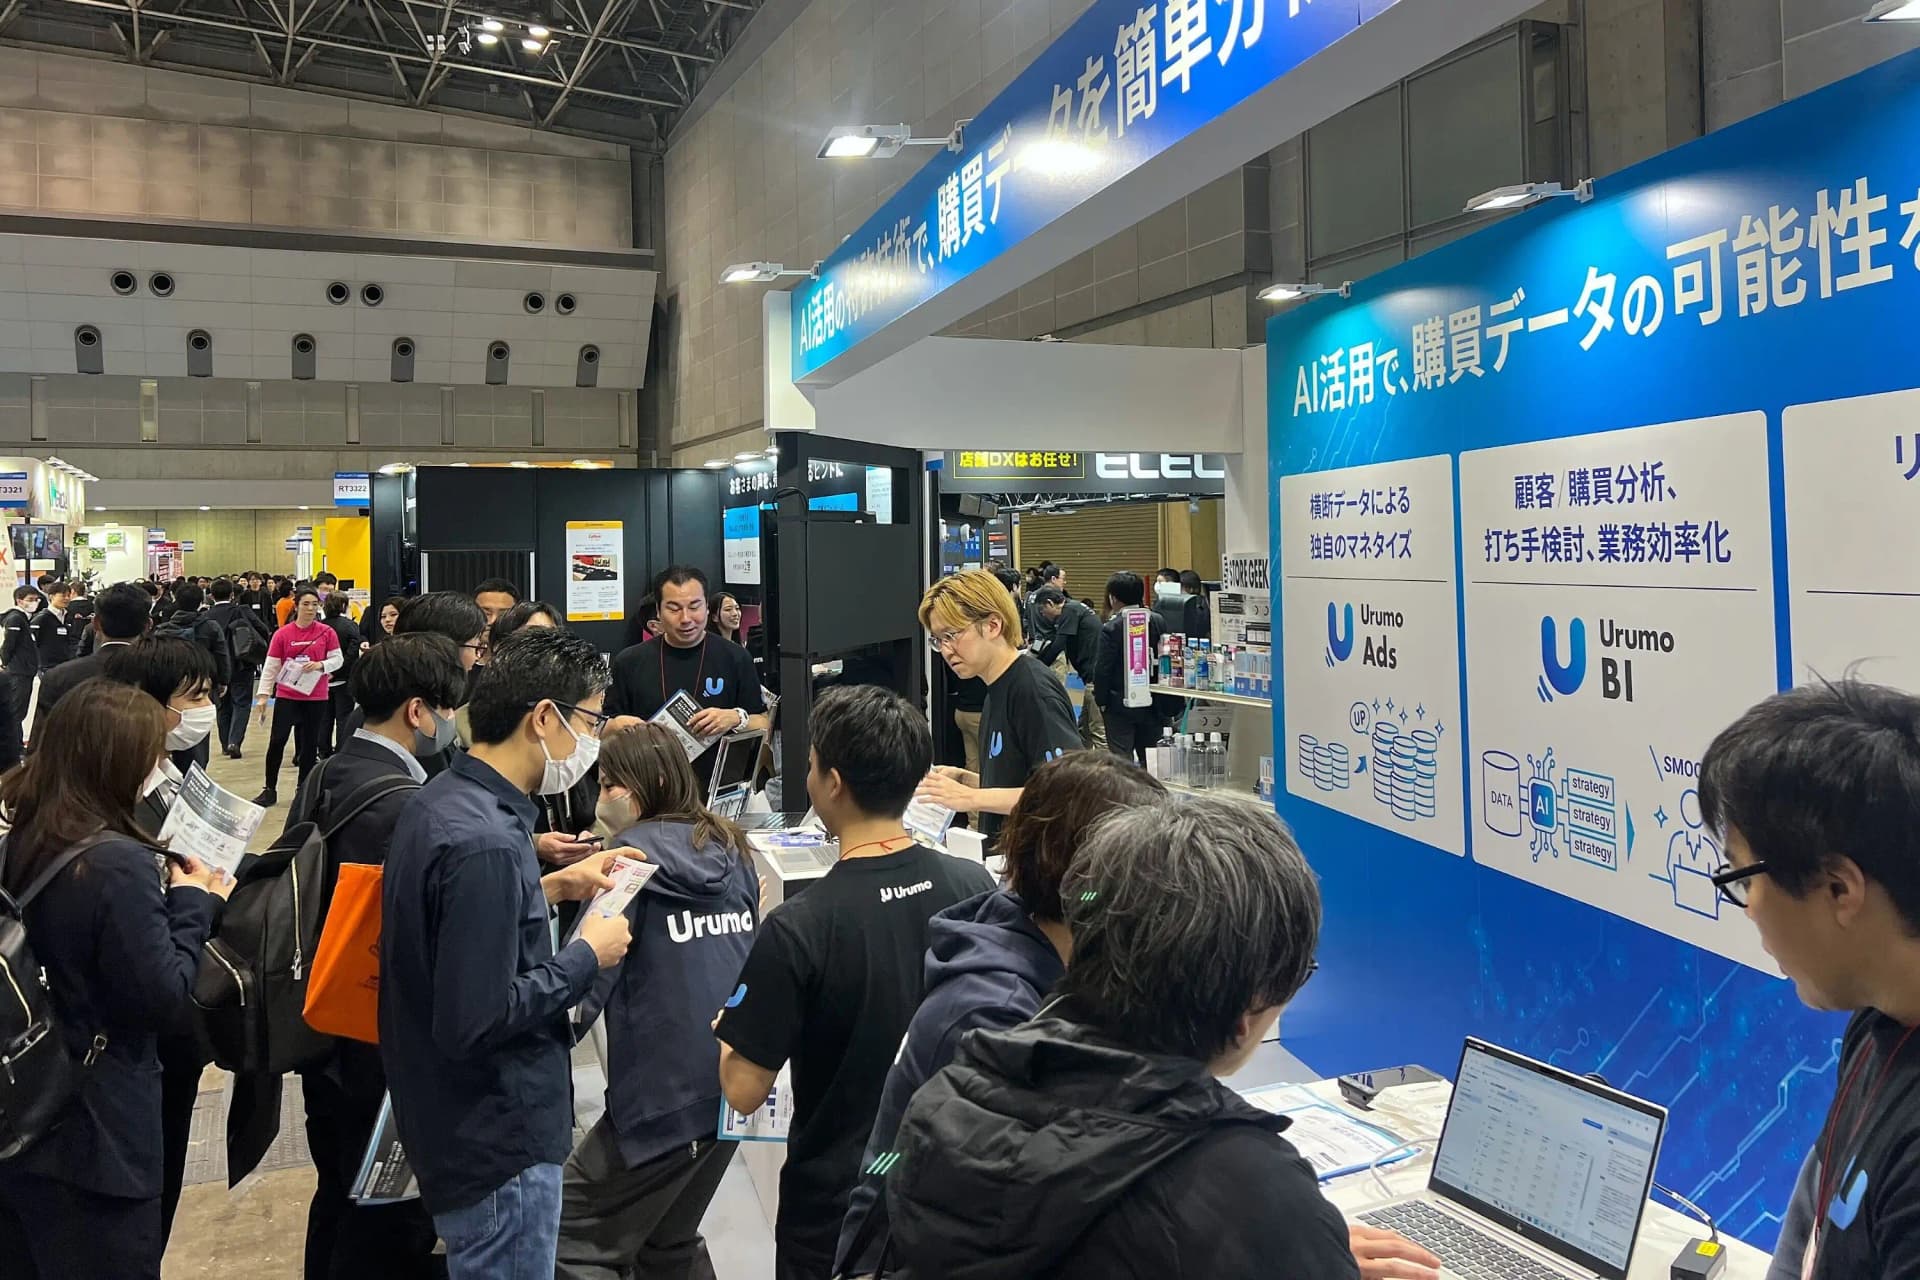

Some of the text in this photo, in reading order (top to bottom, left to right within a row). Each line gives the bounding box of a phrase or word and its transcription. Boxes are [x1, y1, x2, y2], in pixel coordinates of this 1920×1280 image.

[338, 485, 367, 493] RT3322
[1310, 486, 1410, 520] 横断データによる
[1310, 527, 1412, 560] 独自のマネタイズ
[1485, 520, 1731, 564] 打ち手検討、業務効率化
[1229, 558, 1270, 589] STORE GEEK
[1361, 603, 1404, 628] Urumo
[1599, 618, 1675, 653] Urumo
[1362, 635, 1398, 669] Ads
[1601, 657, 1633, 702] BI
[1353, 710, 1366, 727] UP
[1572, 774, 1610, 799] strategy
[1491, 790, 1513, 809] DATA
[1535, 797, 1549, 816] AI
[1573, 807, 1611, 832] strategy
[1574, 838, 1612, 862] strategy
[893, 879, 933, 900] Urumo
[666, 909, 753, 944] Urumo
